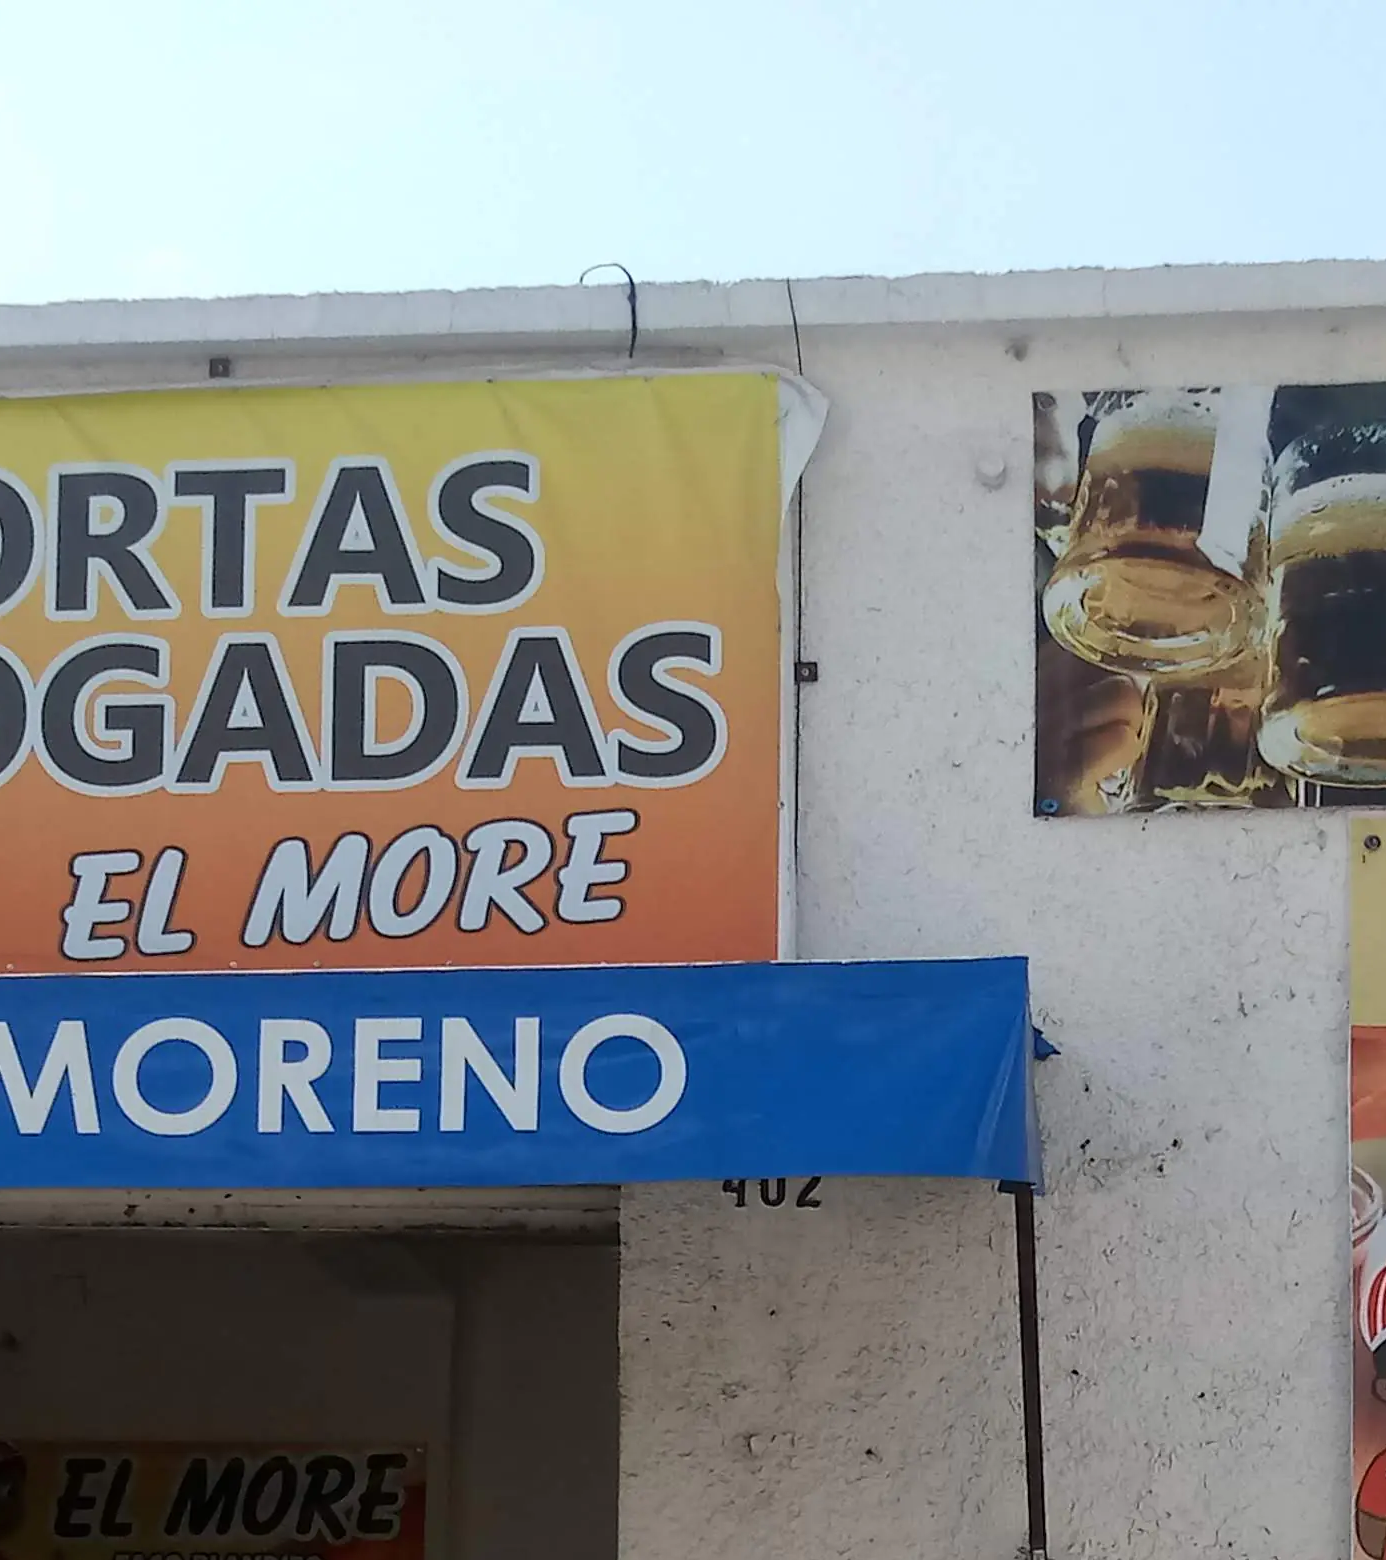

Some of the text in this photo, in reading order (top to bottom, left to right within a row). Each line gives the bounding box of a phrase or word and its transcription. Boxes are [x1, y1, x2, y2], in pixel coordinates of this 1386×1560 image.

[59, 808, 640, 961] EL MORE
[721, 1176, 822, 1208] 402
[52, 1452, 409, 1543] EL MORE
